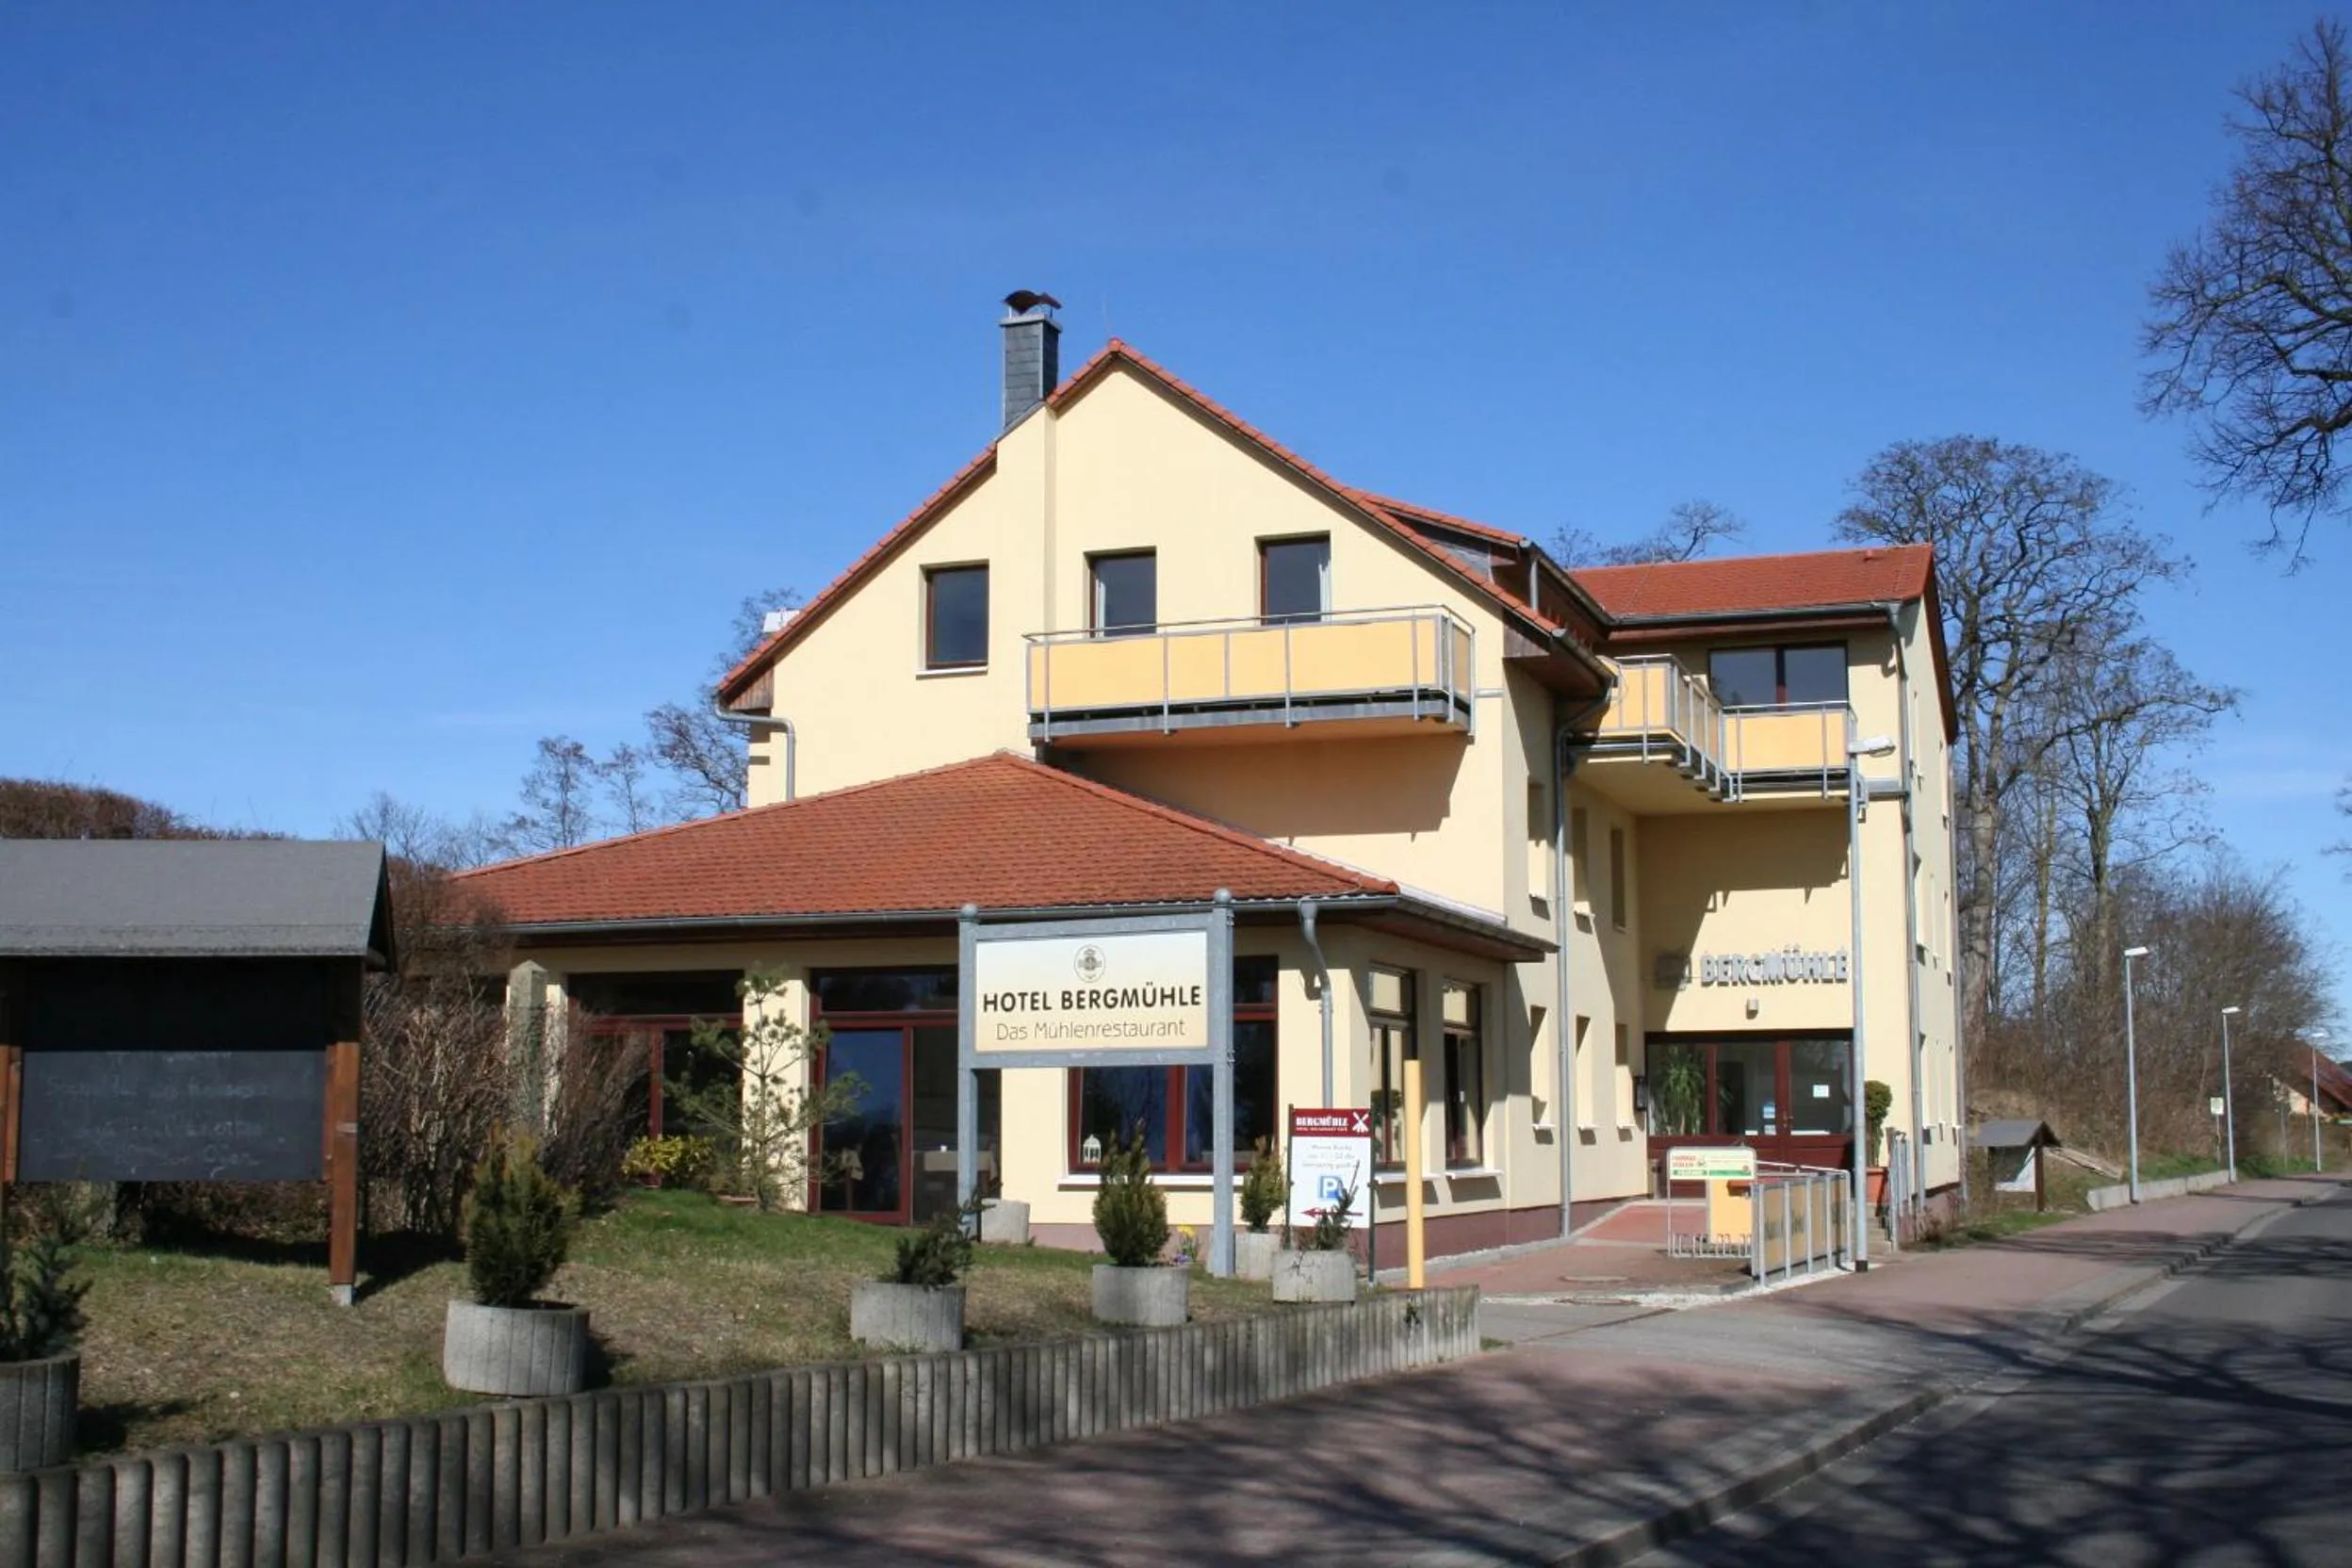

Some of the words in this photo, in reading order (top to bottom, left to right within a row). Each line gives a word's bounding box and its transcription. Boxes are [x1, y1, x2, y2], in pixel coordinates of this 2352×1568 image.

[1700, 944, 1848, 984] BERGMÜHLE
[983, 991, 1053, 1013] HOTEL
[1060, 981, 1201, 1011] BERGMÜHLE
[996, 1022, 1028, 1041] Das
[1034, 1019, 1186, 1039] Mühlenrestaurant
